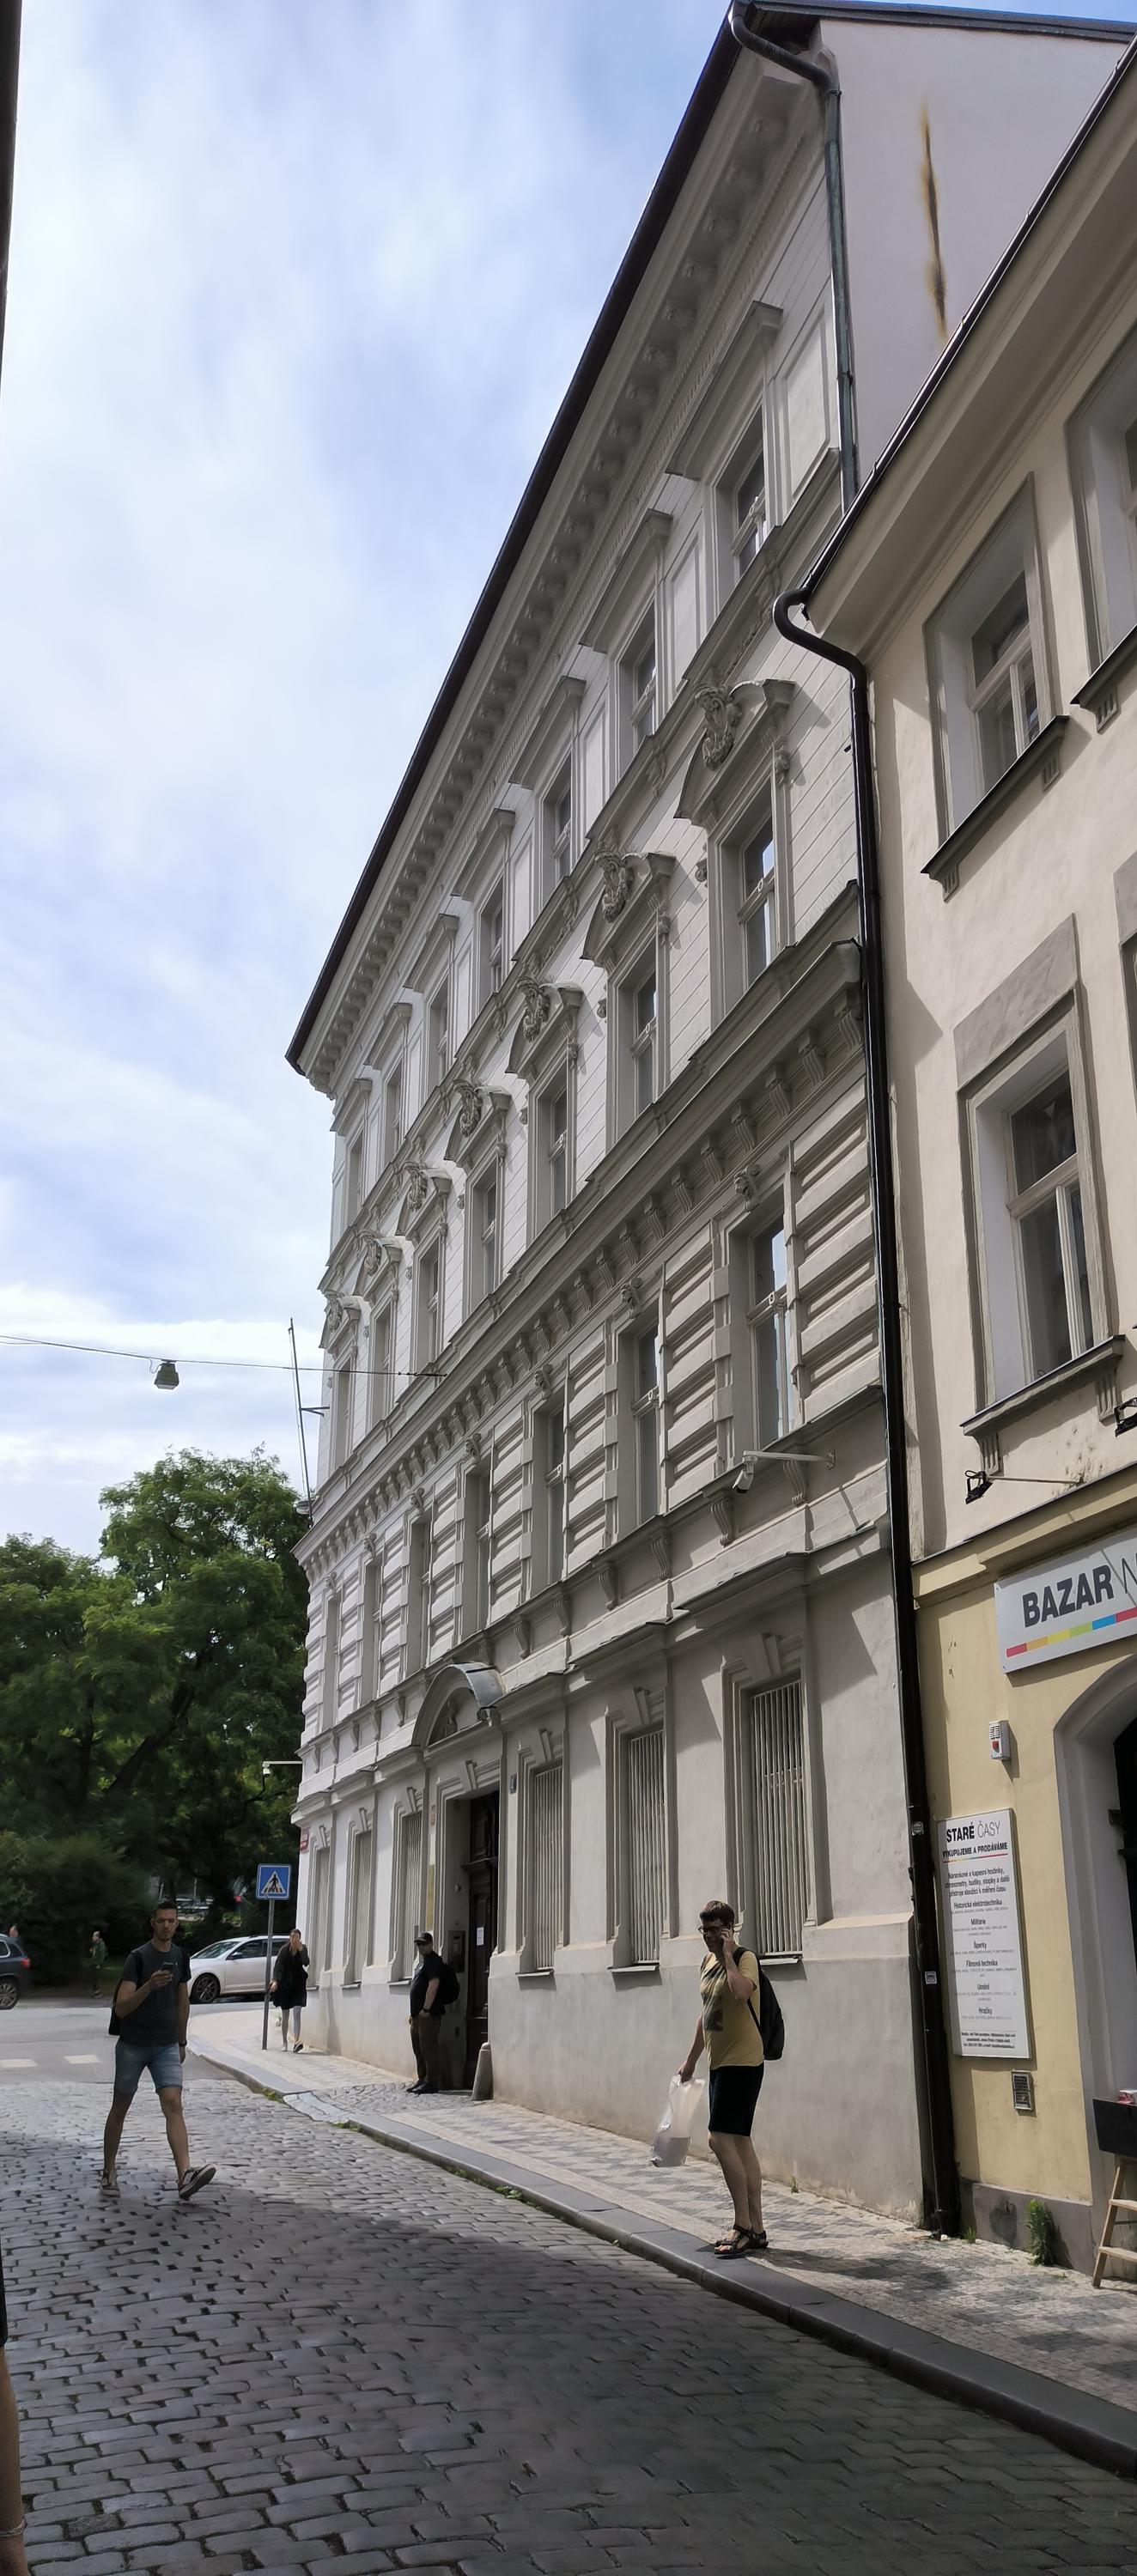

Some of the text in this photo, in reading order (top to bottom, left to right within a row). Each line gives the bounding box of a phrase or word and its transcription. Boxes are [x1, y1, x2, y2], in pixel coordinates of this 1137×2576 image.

[1023, 1565, 1114, 1627] BAZAR
[946, 1820, 1000, 1842] STARÉ ČASY
[942, 1848, 972, 1857] VYKUPUJEME
[978, 1843, 1007, 1852] PRODÁVÁME
